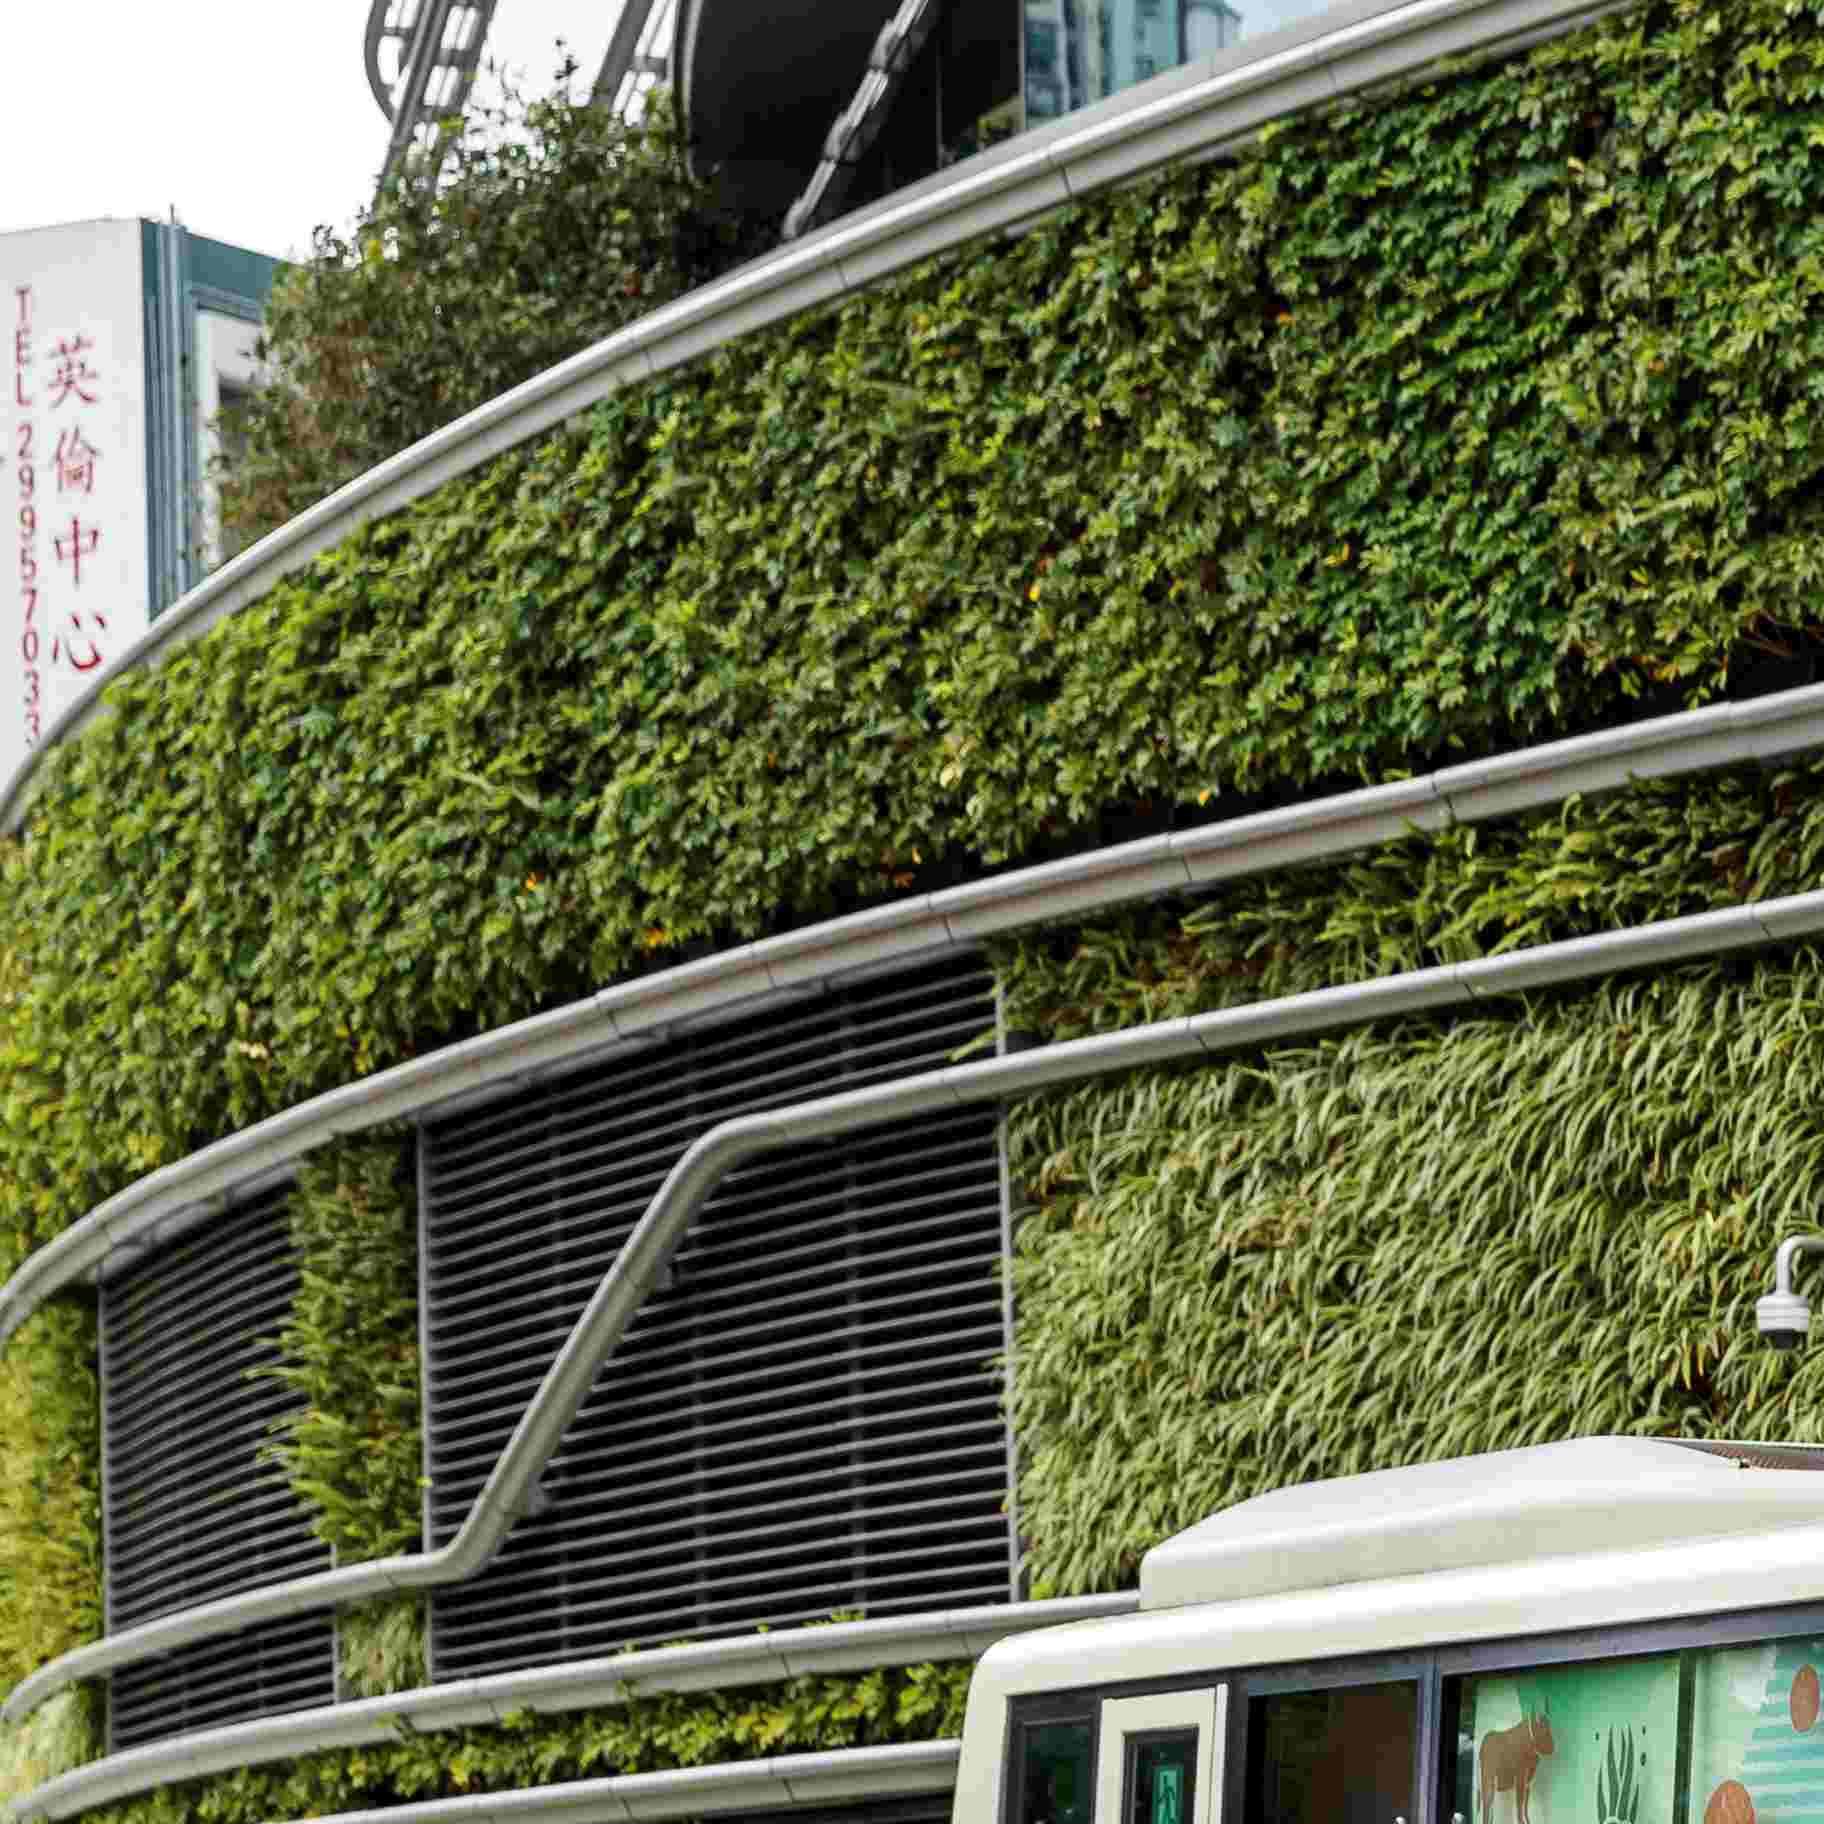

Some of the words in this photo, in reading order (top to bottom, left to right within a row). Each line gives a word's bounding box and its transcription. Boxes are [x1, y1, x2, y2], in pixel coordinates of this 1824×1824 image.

[16, 289, 31, 408] TEL
[47, 335, 108, 674] 英倫中心
